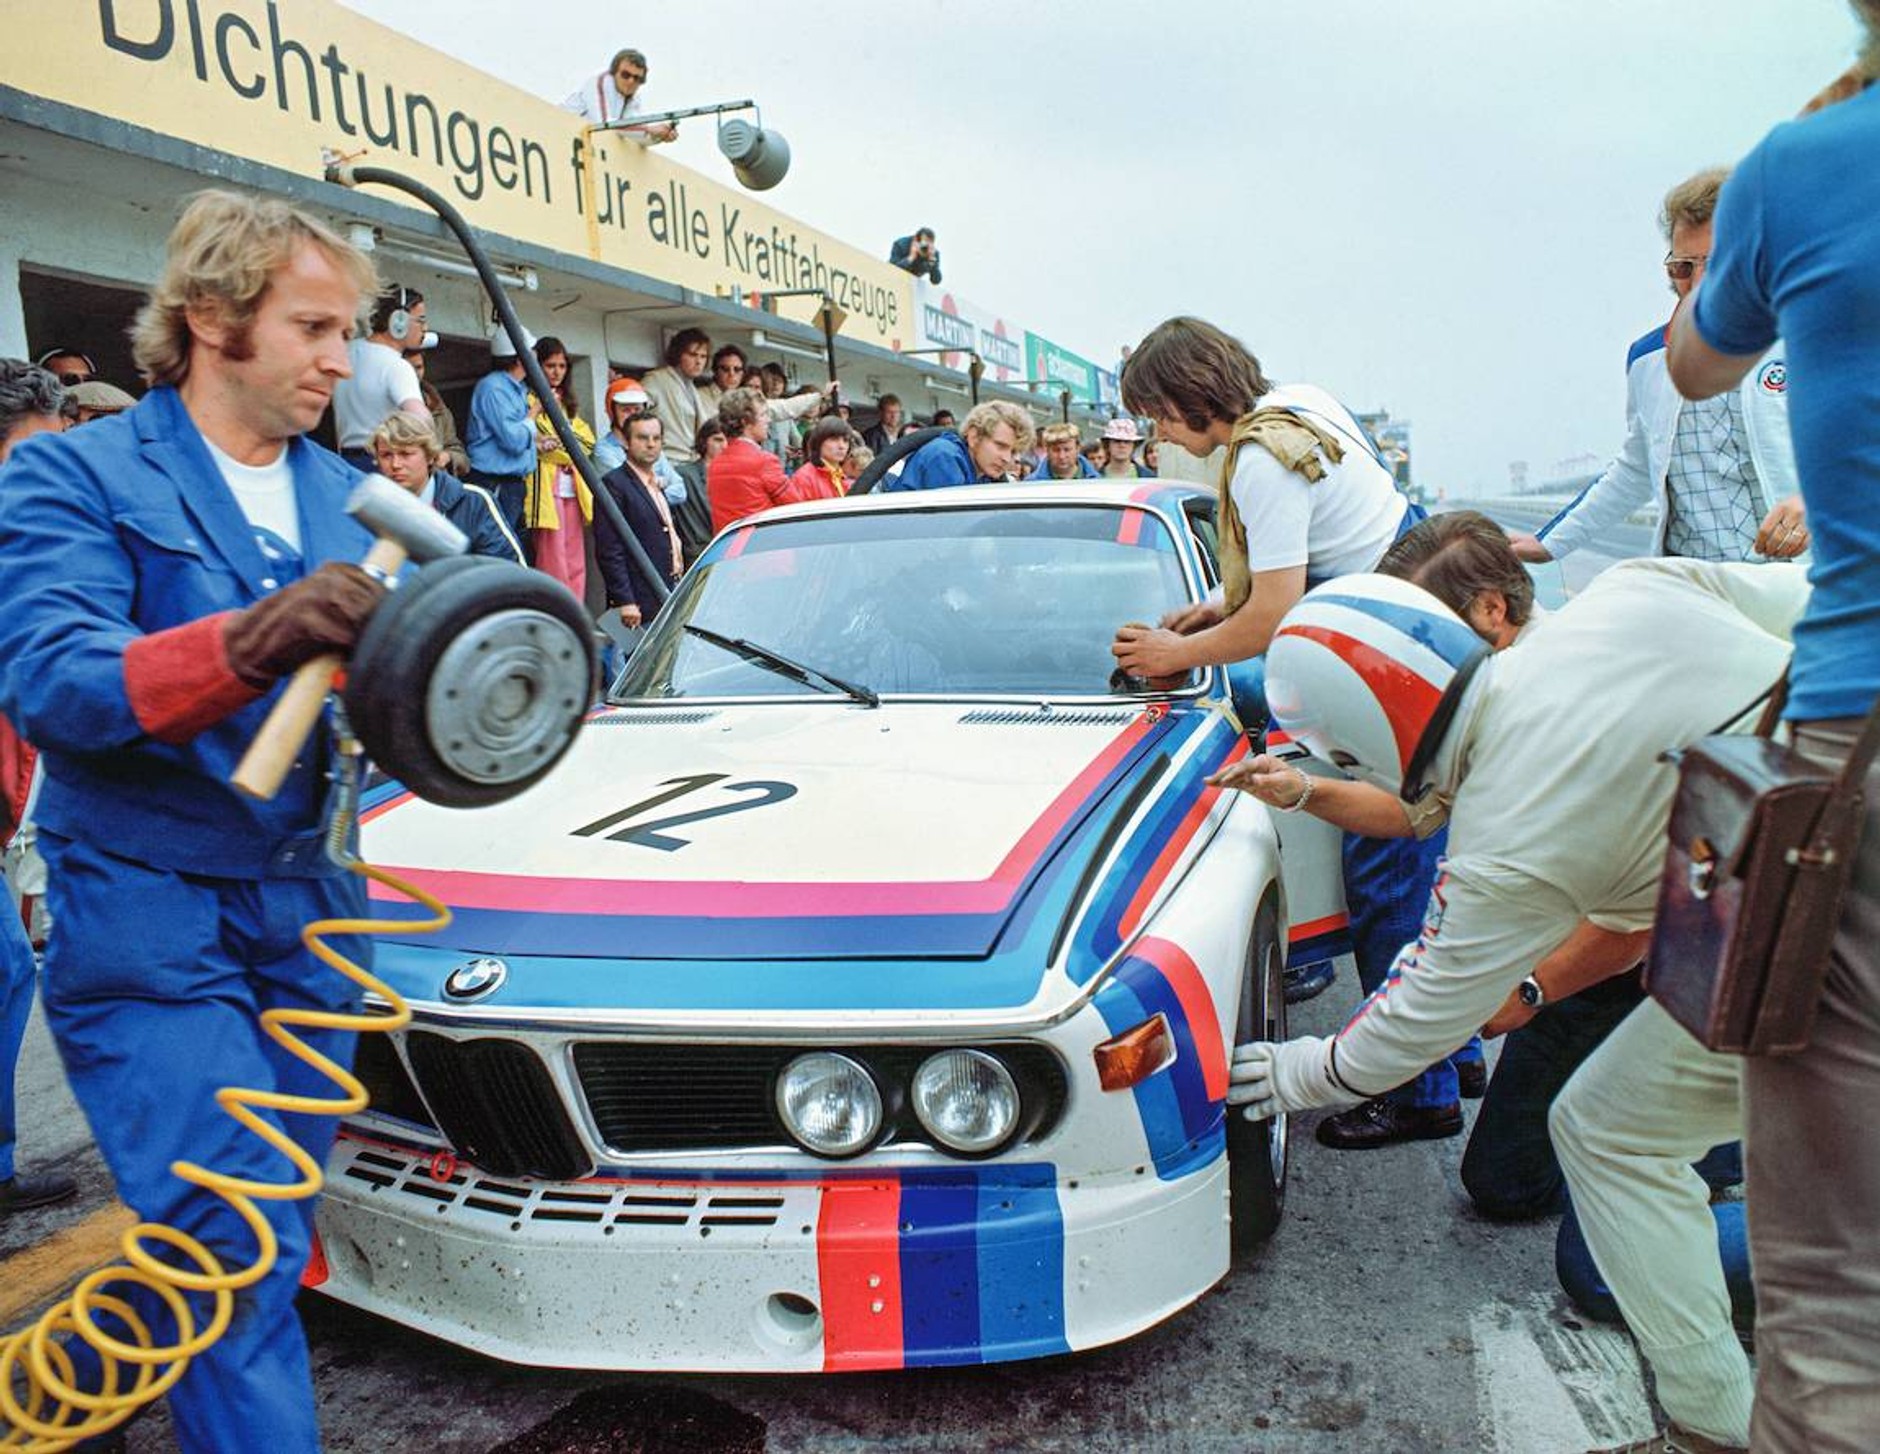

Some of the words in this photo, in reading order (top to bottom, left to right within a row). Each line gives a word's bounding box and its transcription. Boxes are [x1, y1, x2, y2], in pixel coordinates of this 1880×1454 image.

[649, 179, 708, 258] alle
[722, 203, 897, 335] Kraftfahrzeuge
[568, 773, 798, 852] 12
